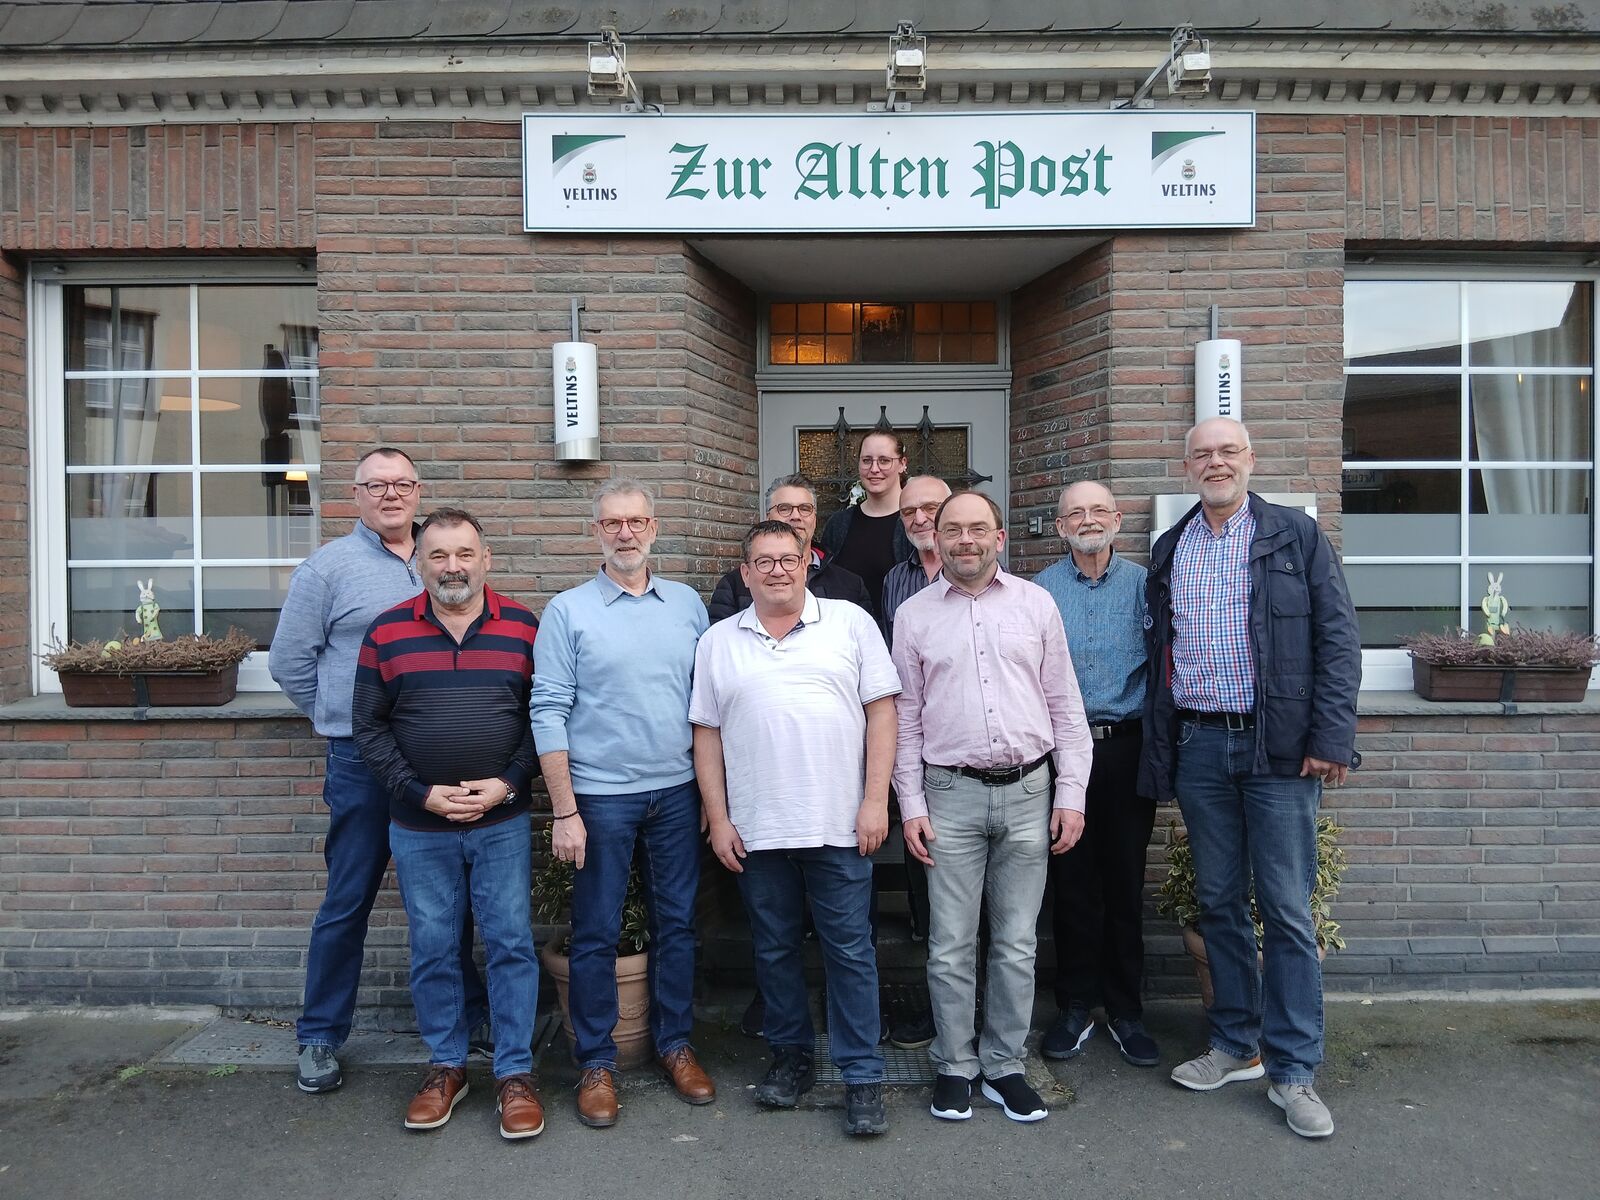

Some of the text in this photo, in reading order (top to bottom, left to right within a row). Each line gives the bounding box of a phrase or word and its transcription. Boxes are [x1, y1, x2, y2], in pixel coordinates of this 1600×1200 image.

[563, 188, 617, 200] VELTINS
[666, 140, 1112, 209] Zur Alten Post
[1162, 184, 1216, 196] VELTINS
[566, 376, 578, 427] VELTINS
[1219, 373, 1230, 415] ELTINS
